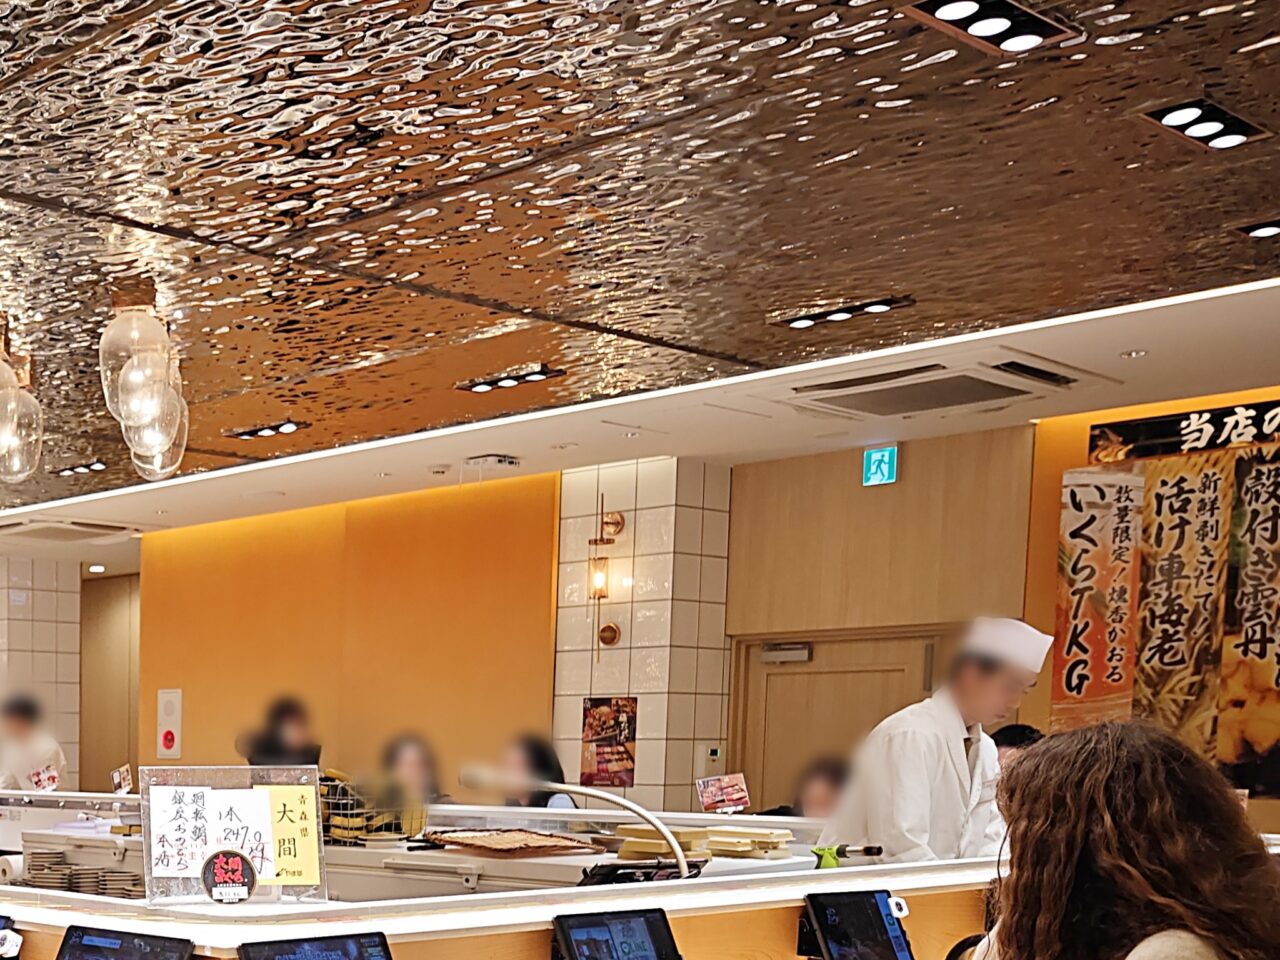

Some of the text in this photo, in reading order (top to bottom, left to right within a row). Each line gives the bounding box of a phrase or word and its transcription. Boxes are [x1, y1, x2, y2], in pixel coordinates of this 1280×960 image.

[1065, 484, 1106, 696] いくらTKG
[1145, 476, 1196, 667] 活け車海老
[276, 803, 297, 858] 大間
